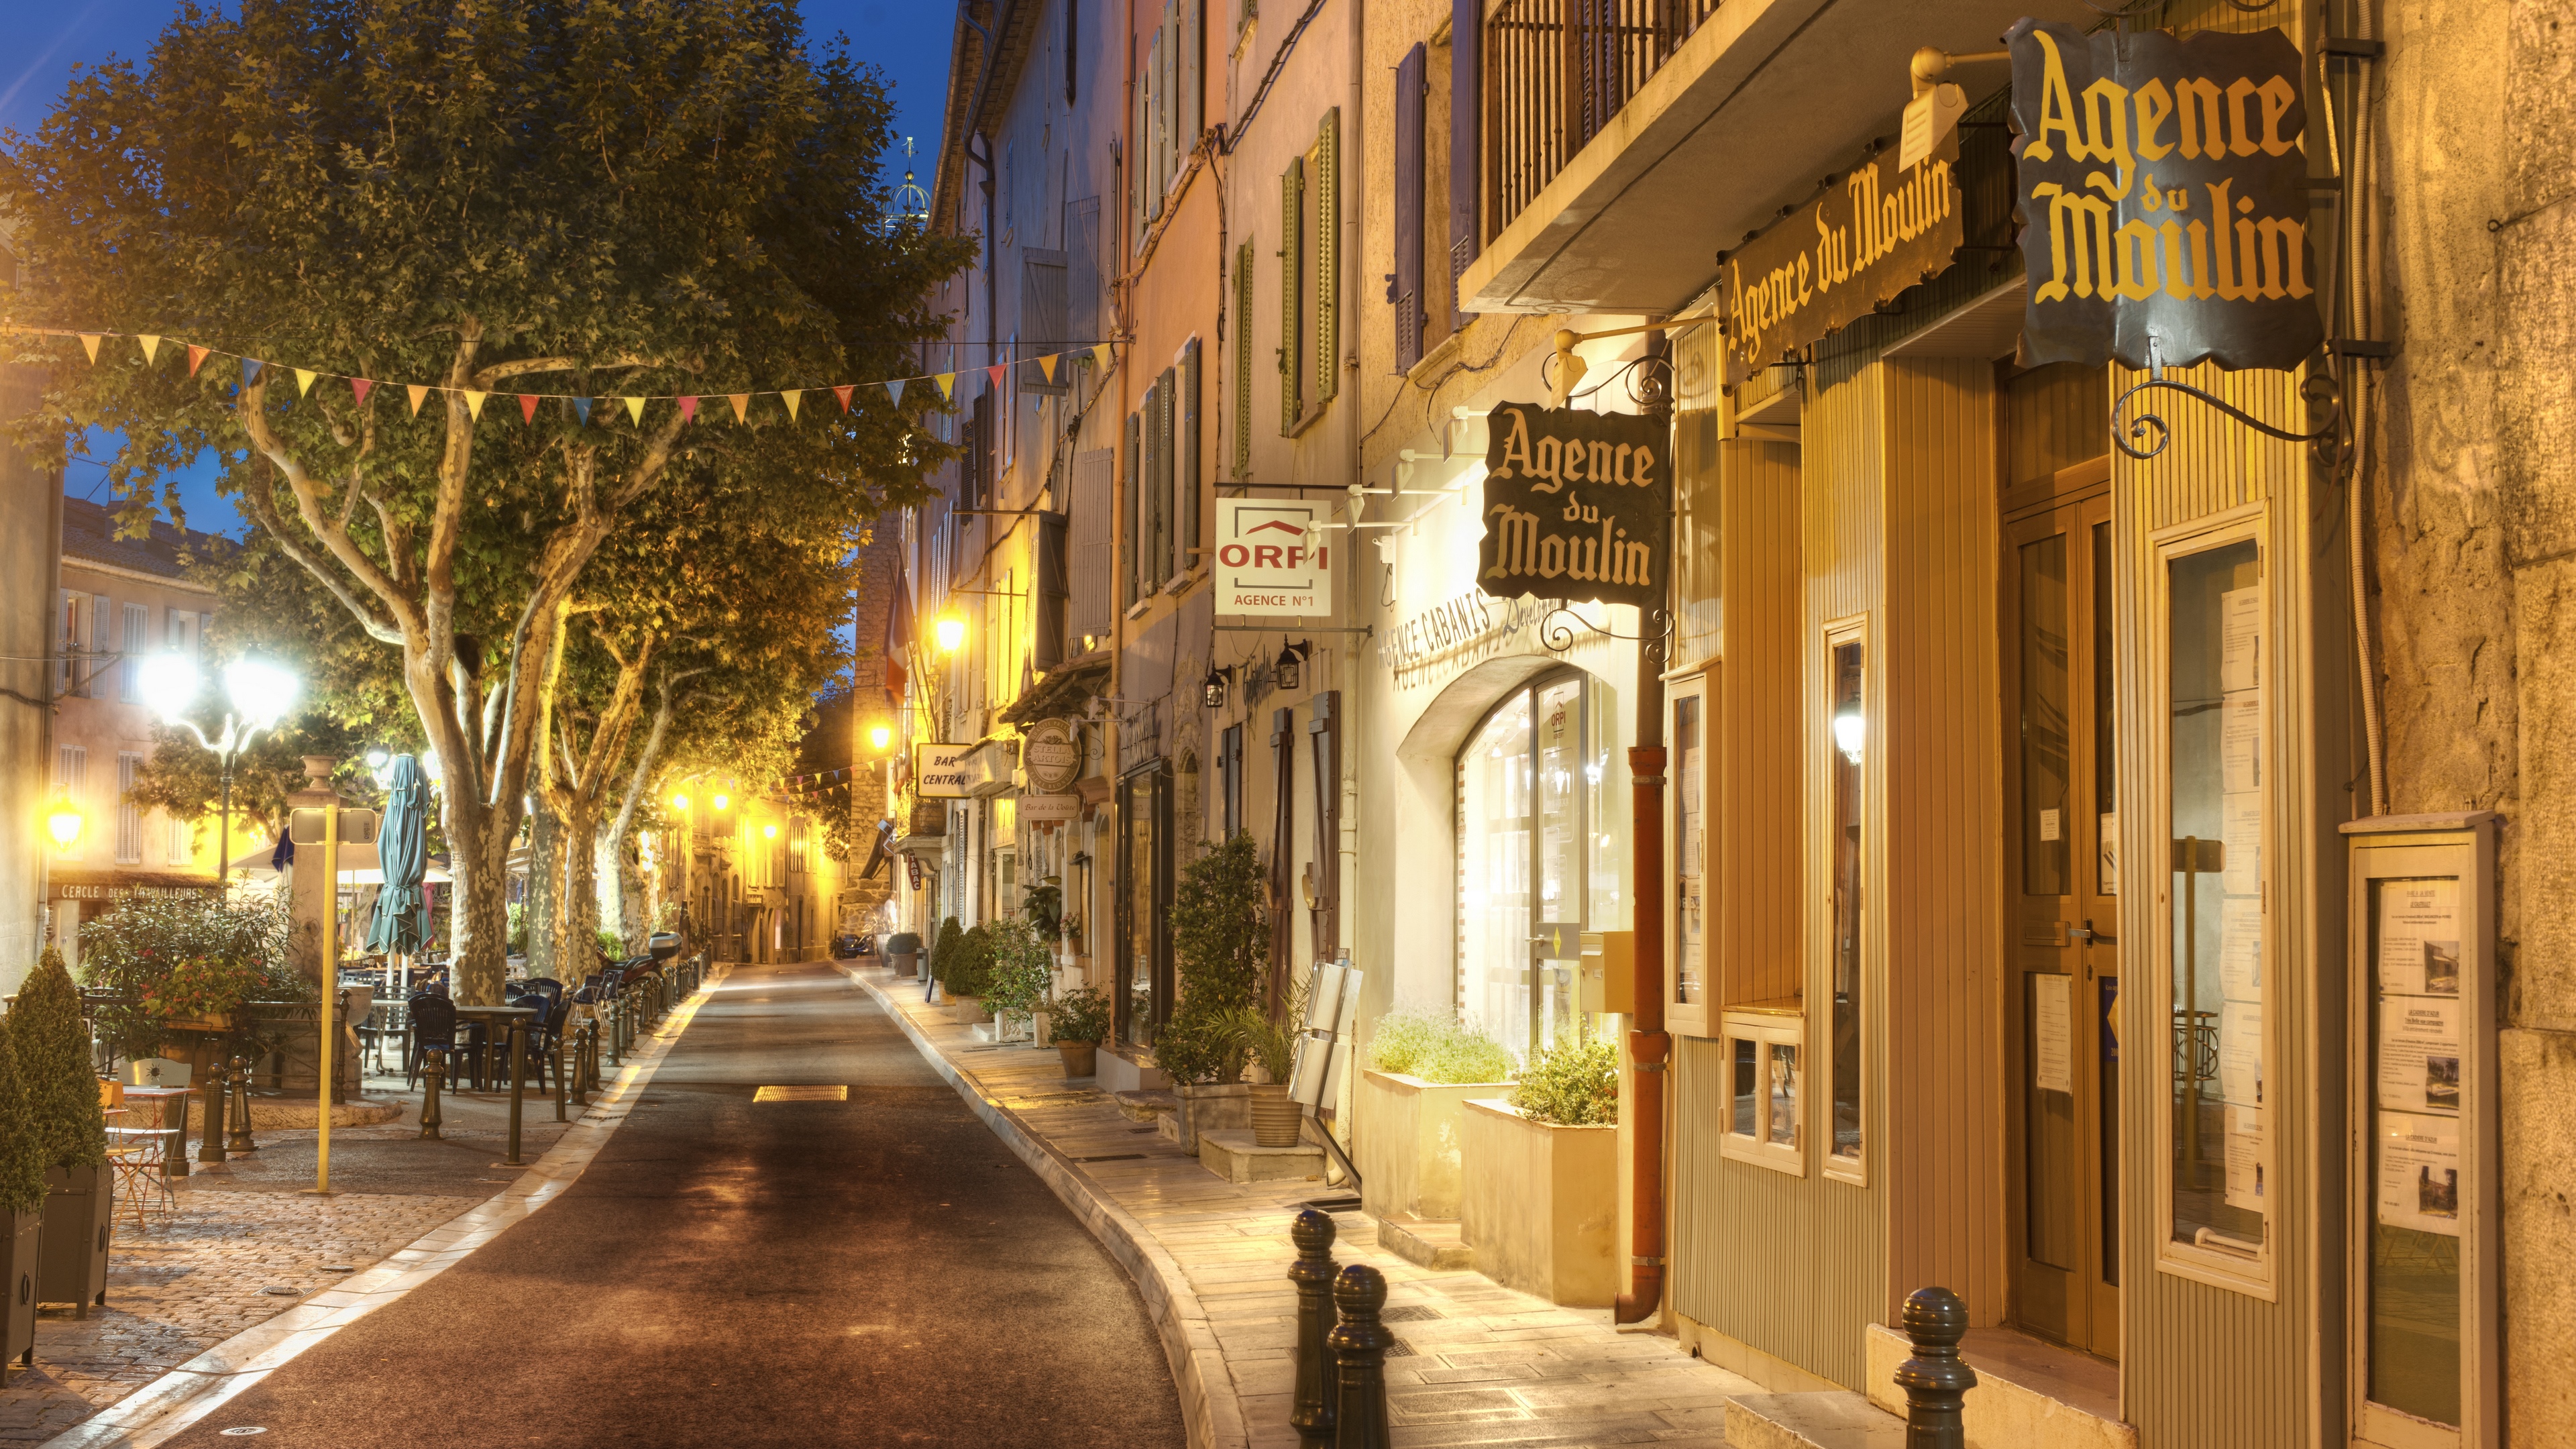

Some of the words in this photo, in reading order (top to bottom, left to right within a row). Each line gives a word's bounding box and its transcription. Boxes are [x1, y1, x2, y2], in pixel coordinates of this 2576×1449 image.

[2023, 30, 2295, 201] Agence
[2140, 173, 2188, 213] du
[2031, 177, 2314, 305] Moulin
[1727, 250, 1813, 364] Agence
[1816, 202, 1849, 293] du
[1848, 155, 1950, 277] Moulin
[1491, 408, 1655, 494] Agence
[1564, 491, 1599, 523] du
[1220, 544, 1328, 570] ORPI
[1485, 504, 1650, 586] Moulin
[1234, 595, 1286, 606] AGENCE
[1293, 596, 1313, 606] N°1
[1378, 619, 1420, 669] AGENCE
[1421, 587, 1491, 651] CABANIS
[1551, 711, 1566, 727] ORPI
[934, 756, 956, 767] BAR
[1032, 755, 1072, 763] ARTOIS
[1034, 745, 1071, 755] STELLA
[923, 775, 965, 785] CENTRAL
[1049, 774, 1073, 789] BLONDE
[910, 855, 920, 889] TABAC
[62, 885, 99, 898] CERCLE
[108, 888, 123, 898] DES
